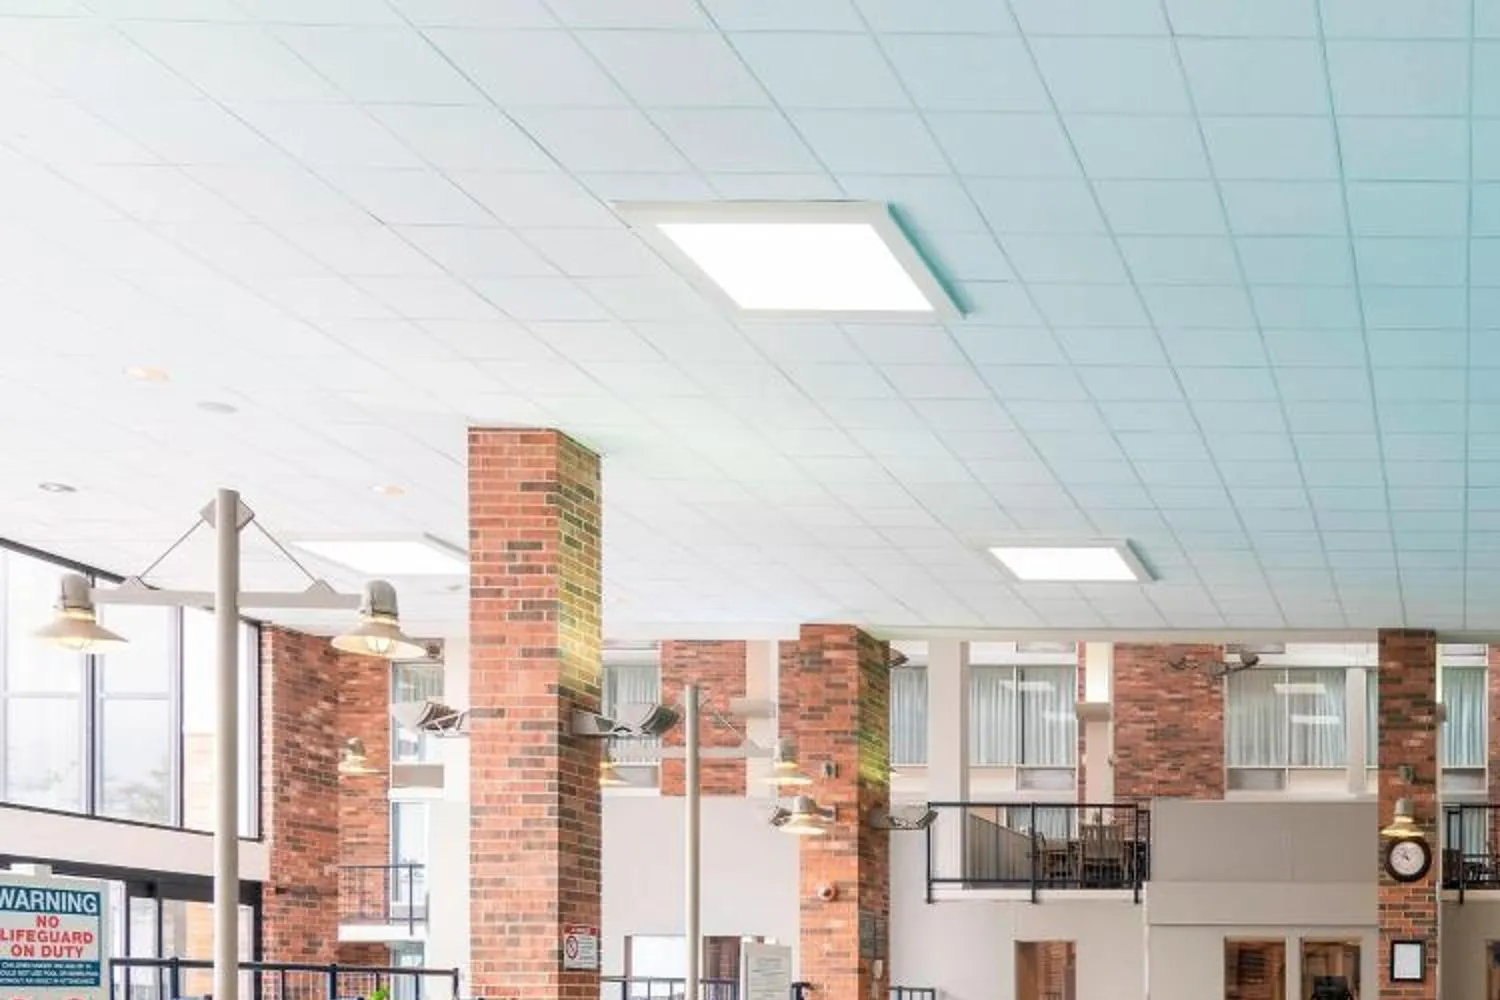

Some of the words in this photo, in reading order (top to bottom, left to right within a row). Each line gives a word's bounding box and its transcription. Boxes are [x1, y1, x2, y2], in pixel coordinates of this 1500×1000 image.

[0, 887, 98, 912] WARNING
[36, 915, 60, 928] NO
[0, 928, 93, 944] LIFEGUARD
[11, 944, 34, 957] ON
[41, 945, 83, 958] DUTY
